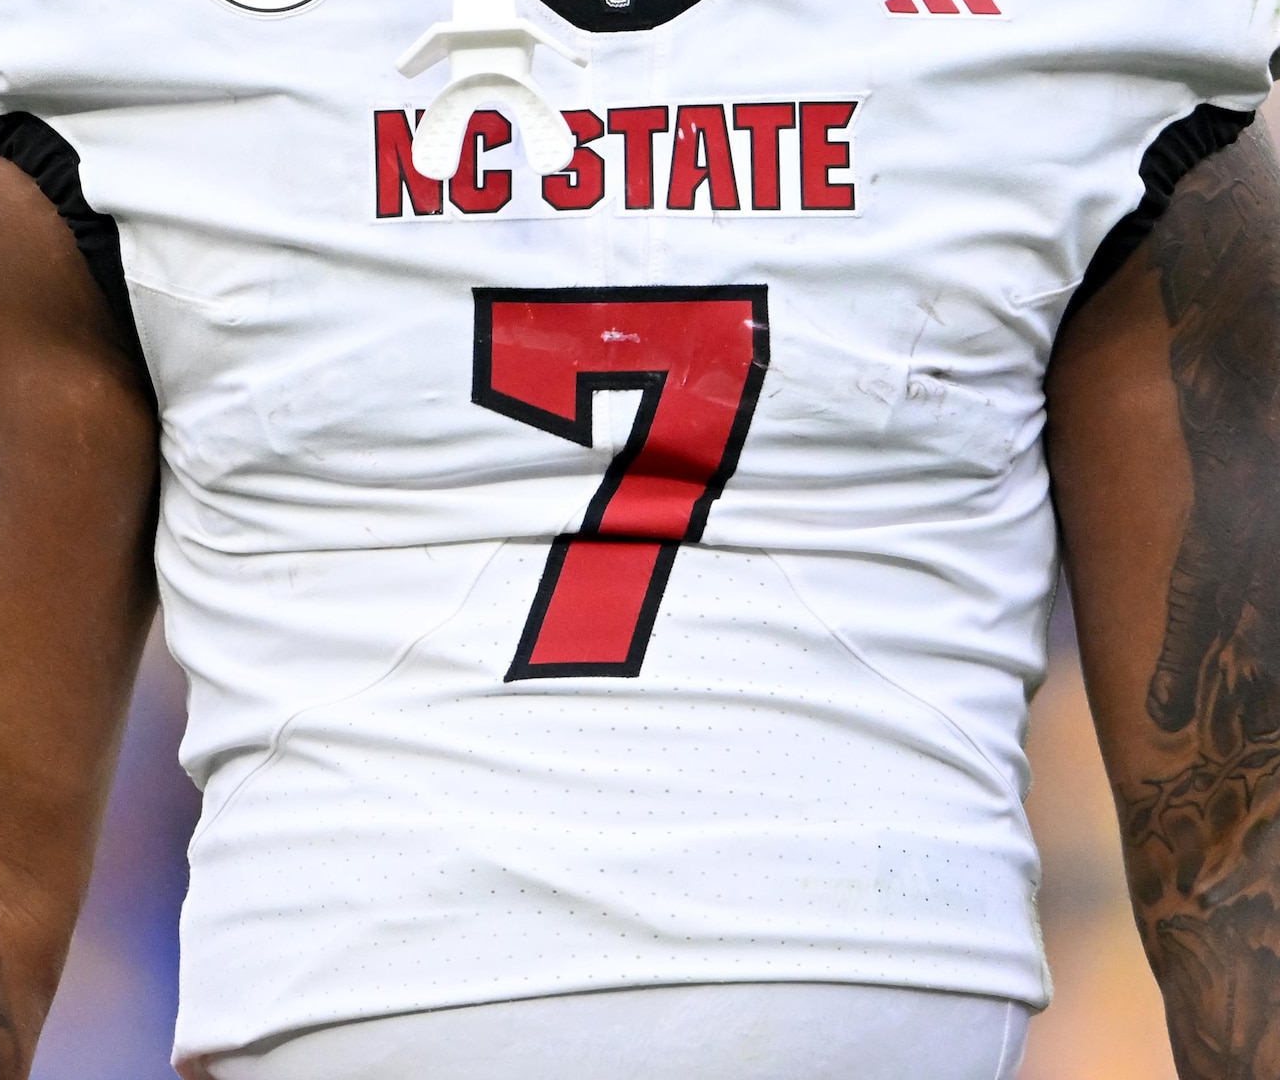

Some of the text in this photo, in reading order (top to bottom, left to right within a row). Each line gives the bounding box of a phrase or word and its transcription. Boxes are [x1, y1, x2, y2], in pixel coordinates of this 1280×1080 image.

[373, 100, 859, 219] NC STATE
[471, 283, 771, 683] 7
